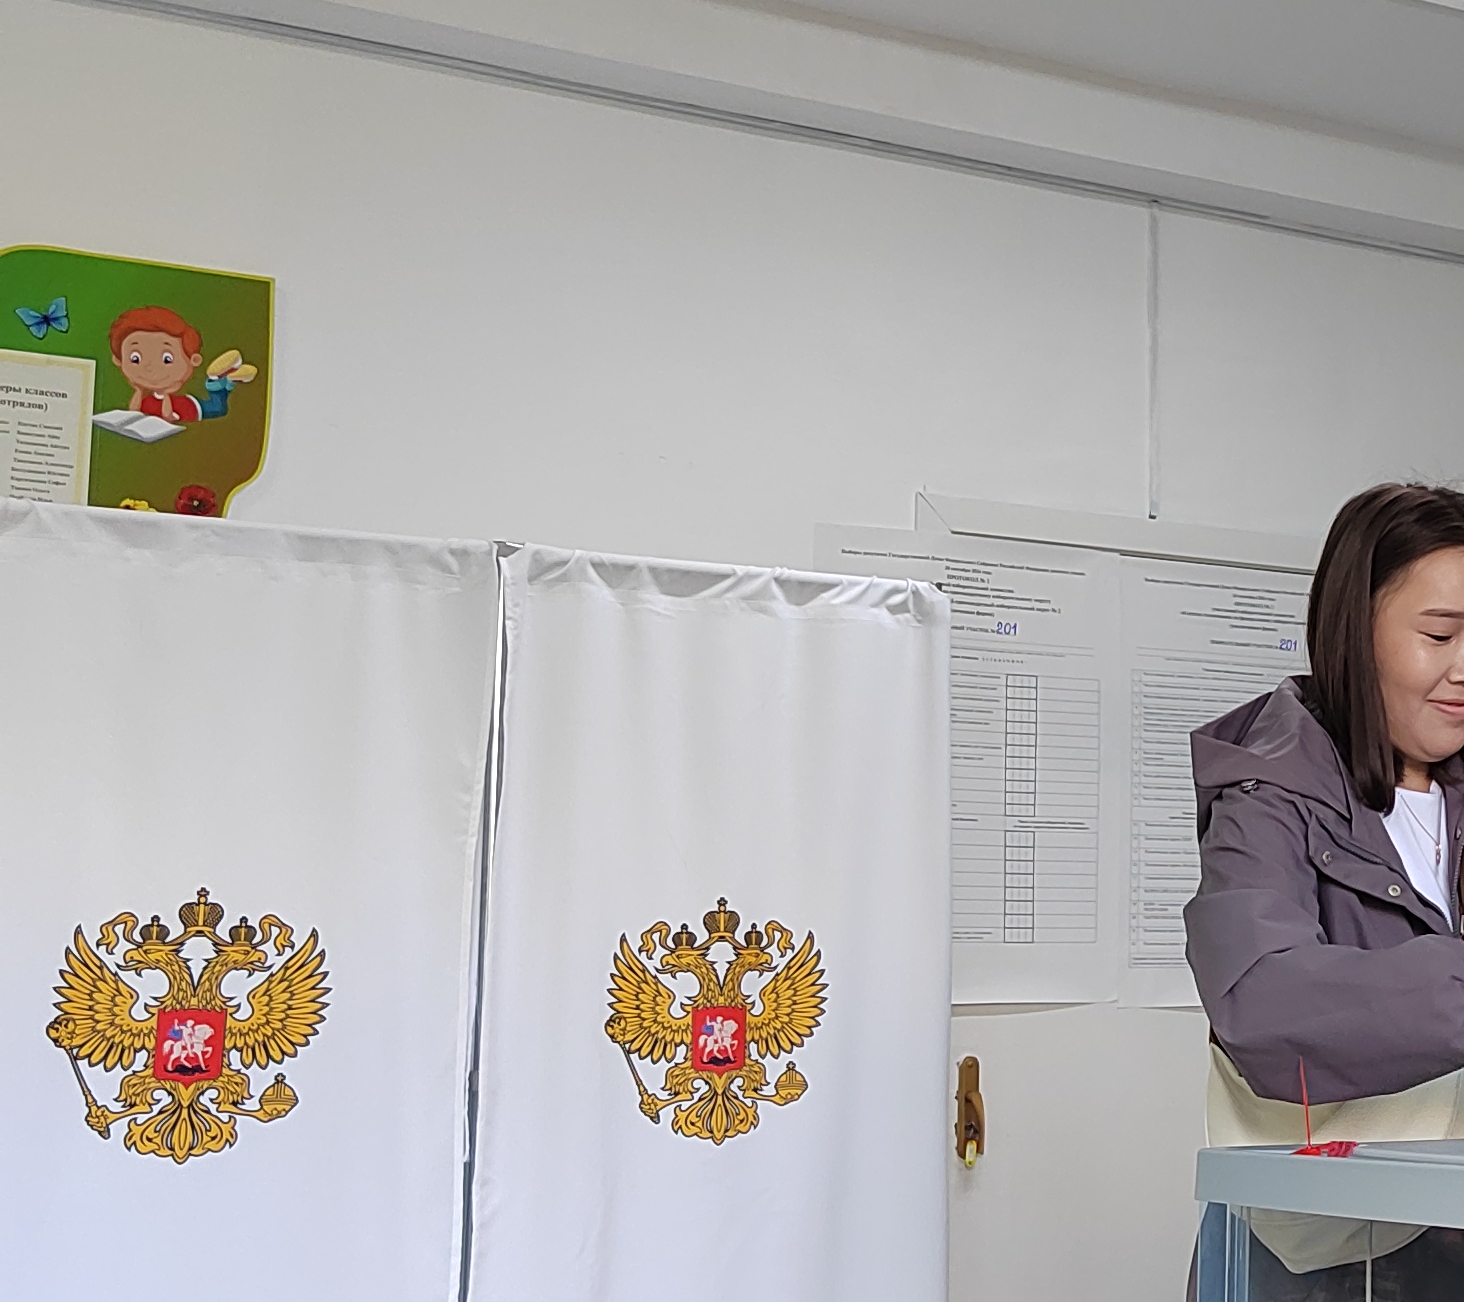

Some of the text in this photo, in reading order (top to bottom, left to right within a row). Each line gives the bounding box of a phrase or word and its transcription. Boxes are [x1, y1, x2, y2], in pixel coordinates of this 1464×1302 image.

[0, 385, 68, 399] еры классов
[996, 621, 1018, 636] 201
[1279, 638, 1298, 652] 201
